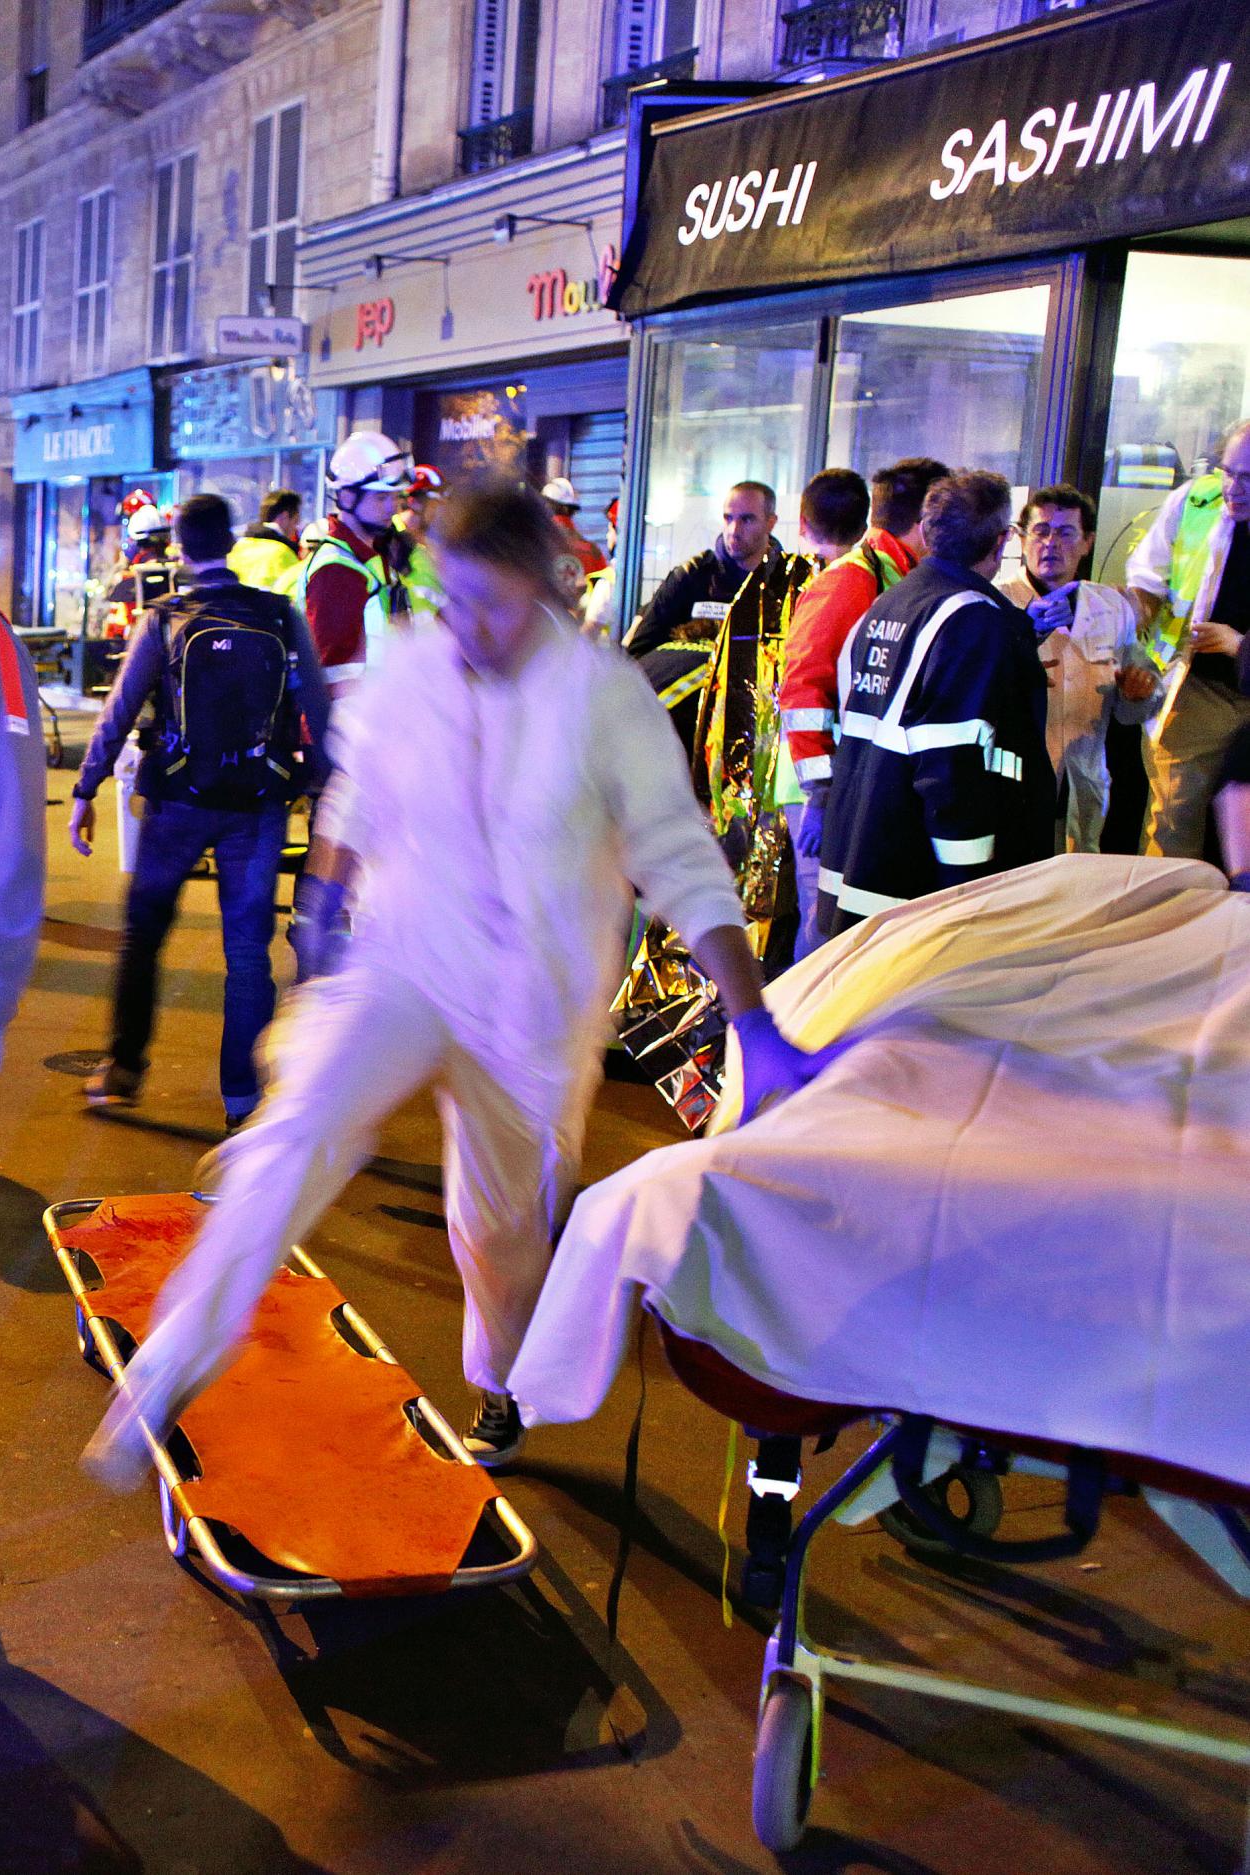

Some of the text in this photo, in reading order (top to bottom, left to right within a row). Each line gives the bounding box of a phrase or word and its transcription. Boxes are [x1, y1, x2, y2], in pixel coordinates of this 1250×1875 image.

[678, 62, 1231, 246] SUSHI SASHIMI
[866, 620, 907, 642] SAMU
[868, 646, 889, 668] DE
